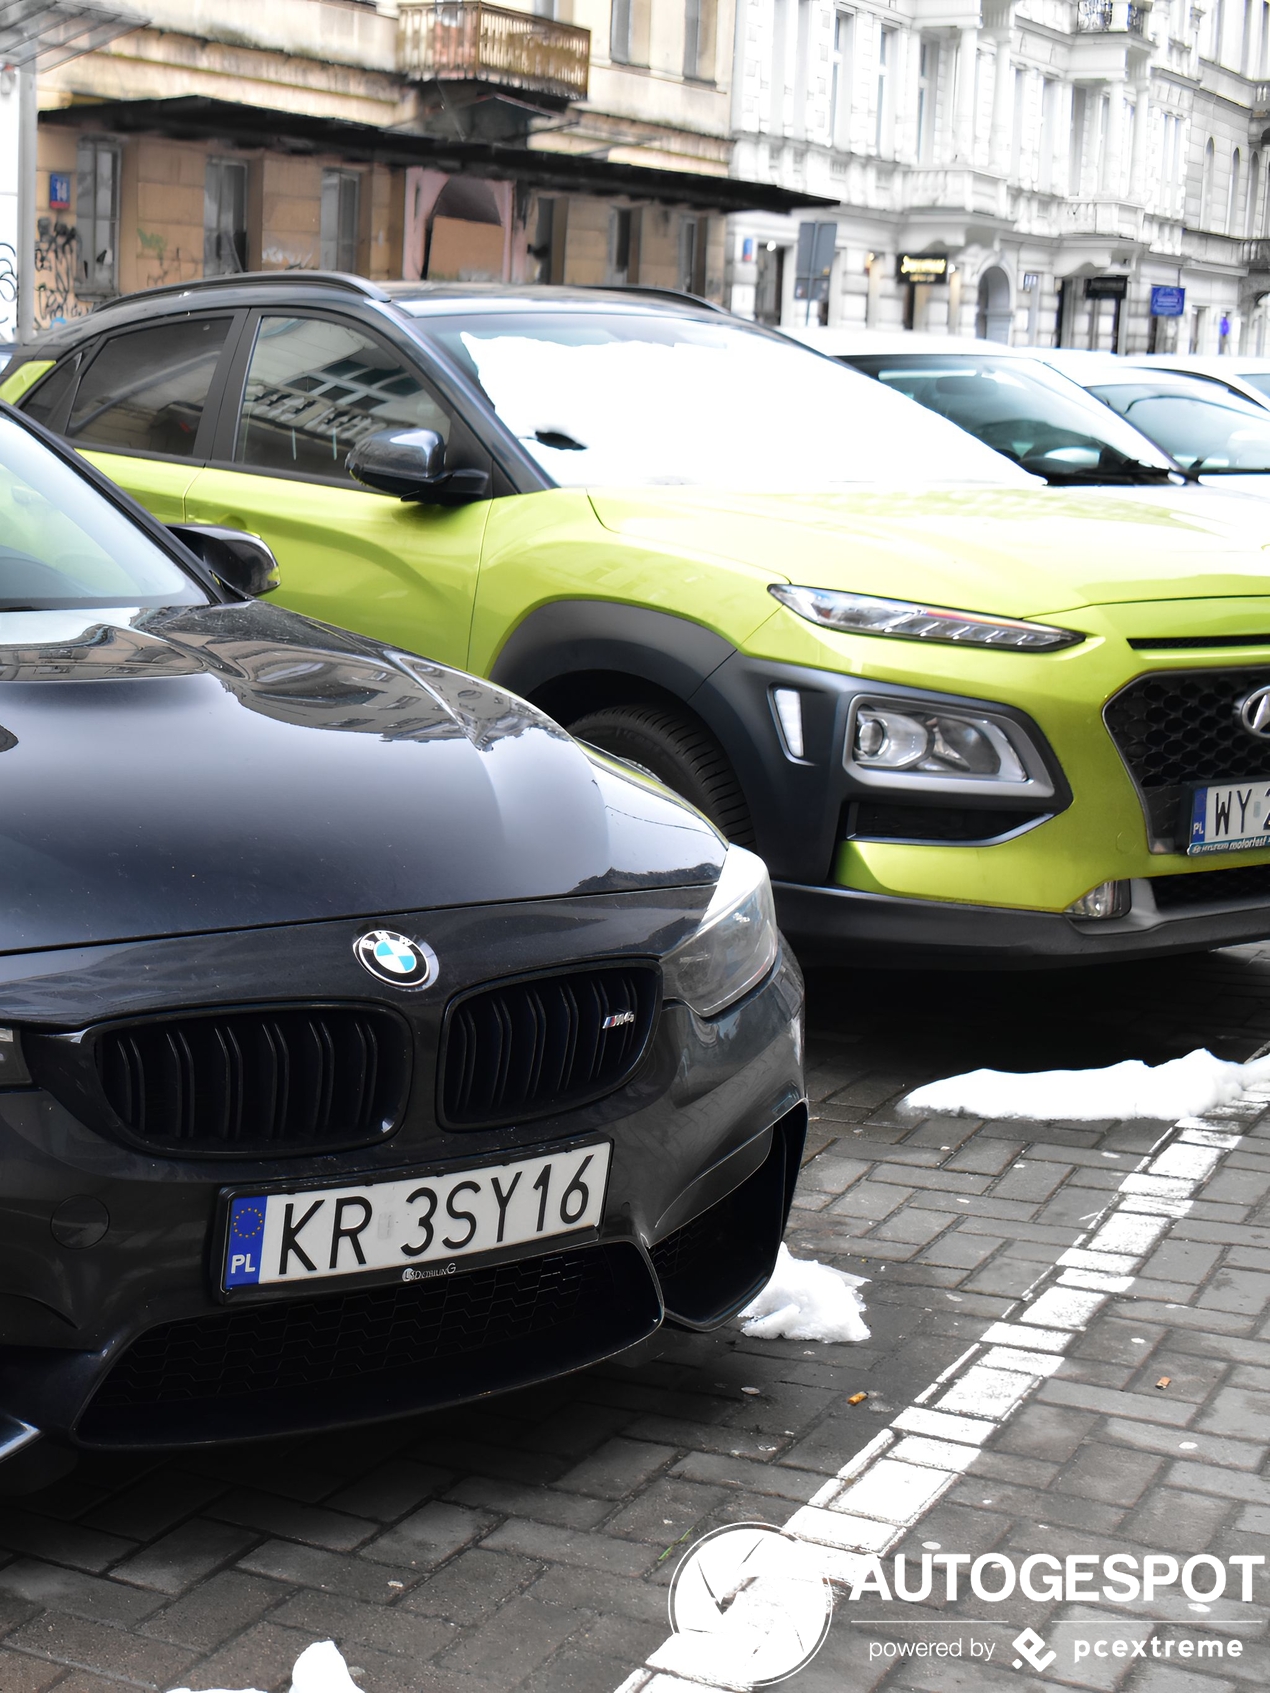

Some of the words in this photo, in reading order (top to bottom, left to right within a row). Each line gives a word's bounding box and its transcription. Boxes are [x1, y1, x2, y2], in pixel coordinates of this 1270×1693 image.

[1192, 821, 1205, 836] PL
[1215, 788, 1252, 837] WY
[278, 1195, 373, 1276] KR
[400, 1153, 595, 1257] 3SY16
[230, 1254, 256, 1274] PL
